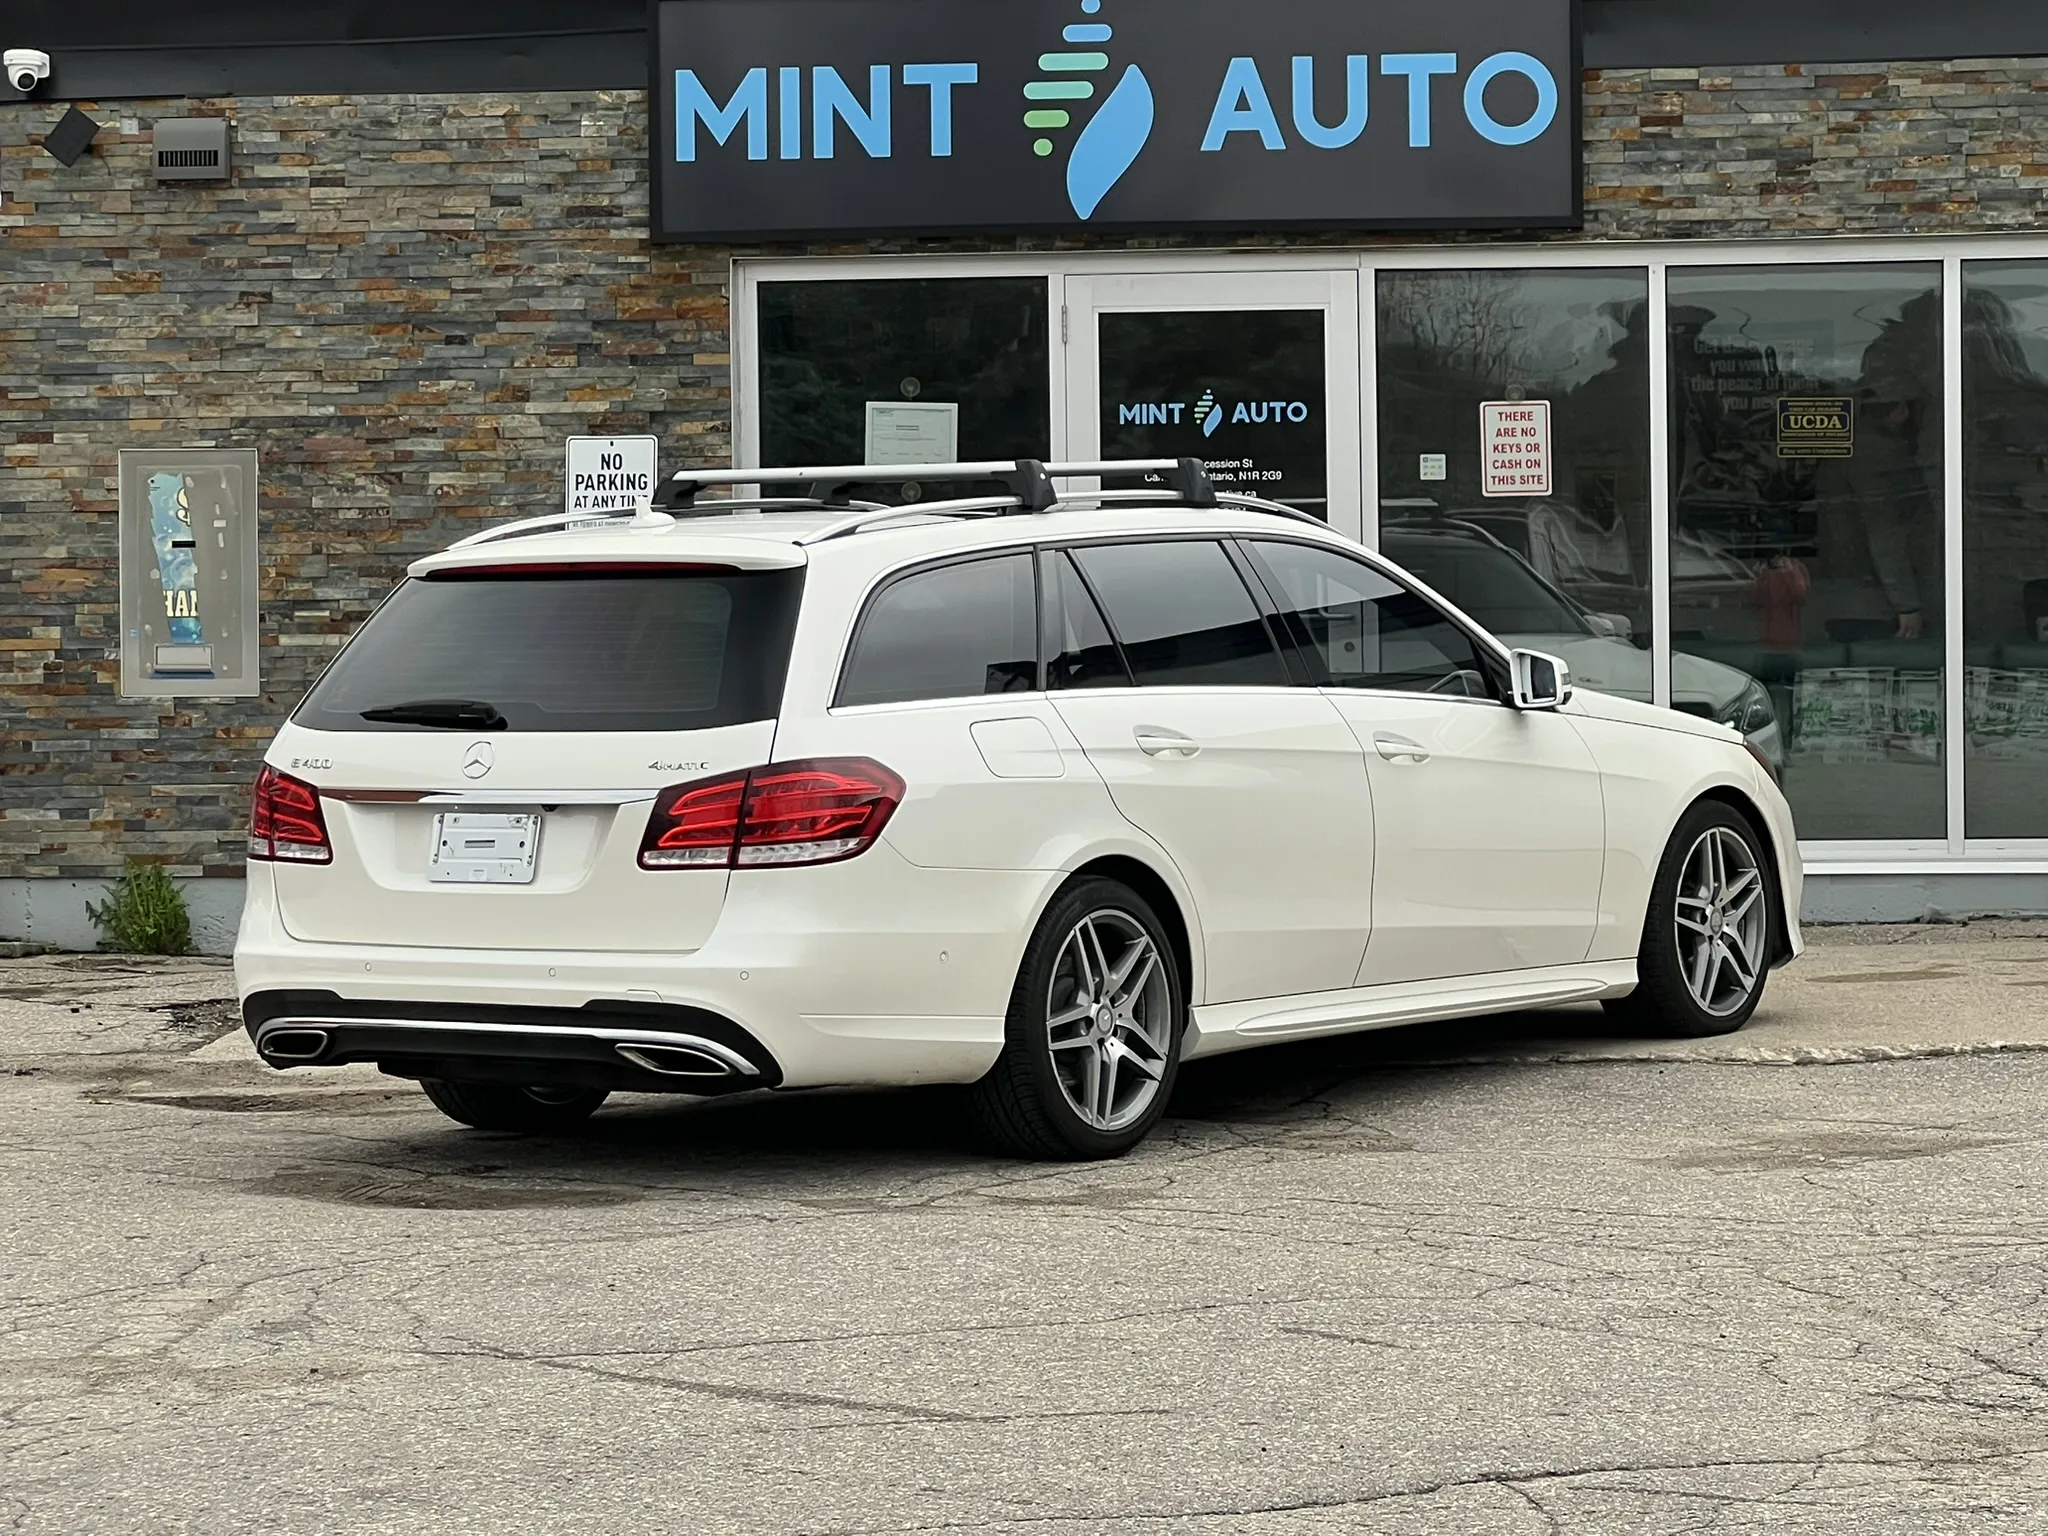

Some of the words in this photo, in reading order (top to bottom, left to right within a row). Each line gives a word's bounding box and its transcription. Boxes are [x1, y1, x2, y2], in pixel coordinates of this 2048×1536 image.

[675, 63, 978, 162] MINT
[1201, 51, 1558, 152] AUTO
[1119, 403, 1185, 425] MINT
[1231, 401, 1308, 423] AUTO
[1498, 411, 1534, 422] THERE
[1789, 415, 1842, 429] UCDA
[1495, 427, 1517, 438] ARE
[1521, 427, 1537, 437] NO
[1493, 443, 1522, 454] KEYS
[1525, 443, 1540, 453] OR
[600, 453, 623, 471] NO
[1203, 459, 1241, 468] cession
[1242, 458, 1253, 468] St
[1492, 459, 1522, 470] CASH
[1525, 459, 1541, 469] ON
[575, 473, 648, 491] PARKING
[1208, 471, 1237, 482] ntario,
[1238, 471, 1260, 480] N1R
[1262, 471, 1283, 480] 2G9
[1491, 475, 1516, 486] THIS
[1519, 474, 1544, 485] SITE
[574, 495, 589, 508] AT
[592, 495, 616, 508] ANY
[290, 758, 301, 769] E
[648, 760, 709, 771] 4MATIC
